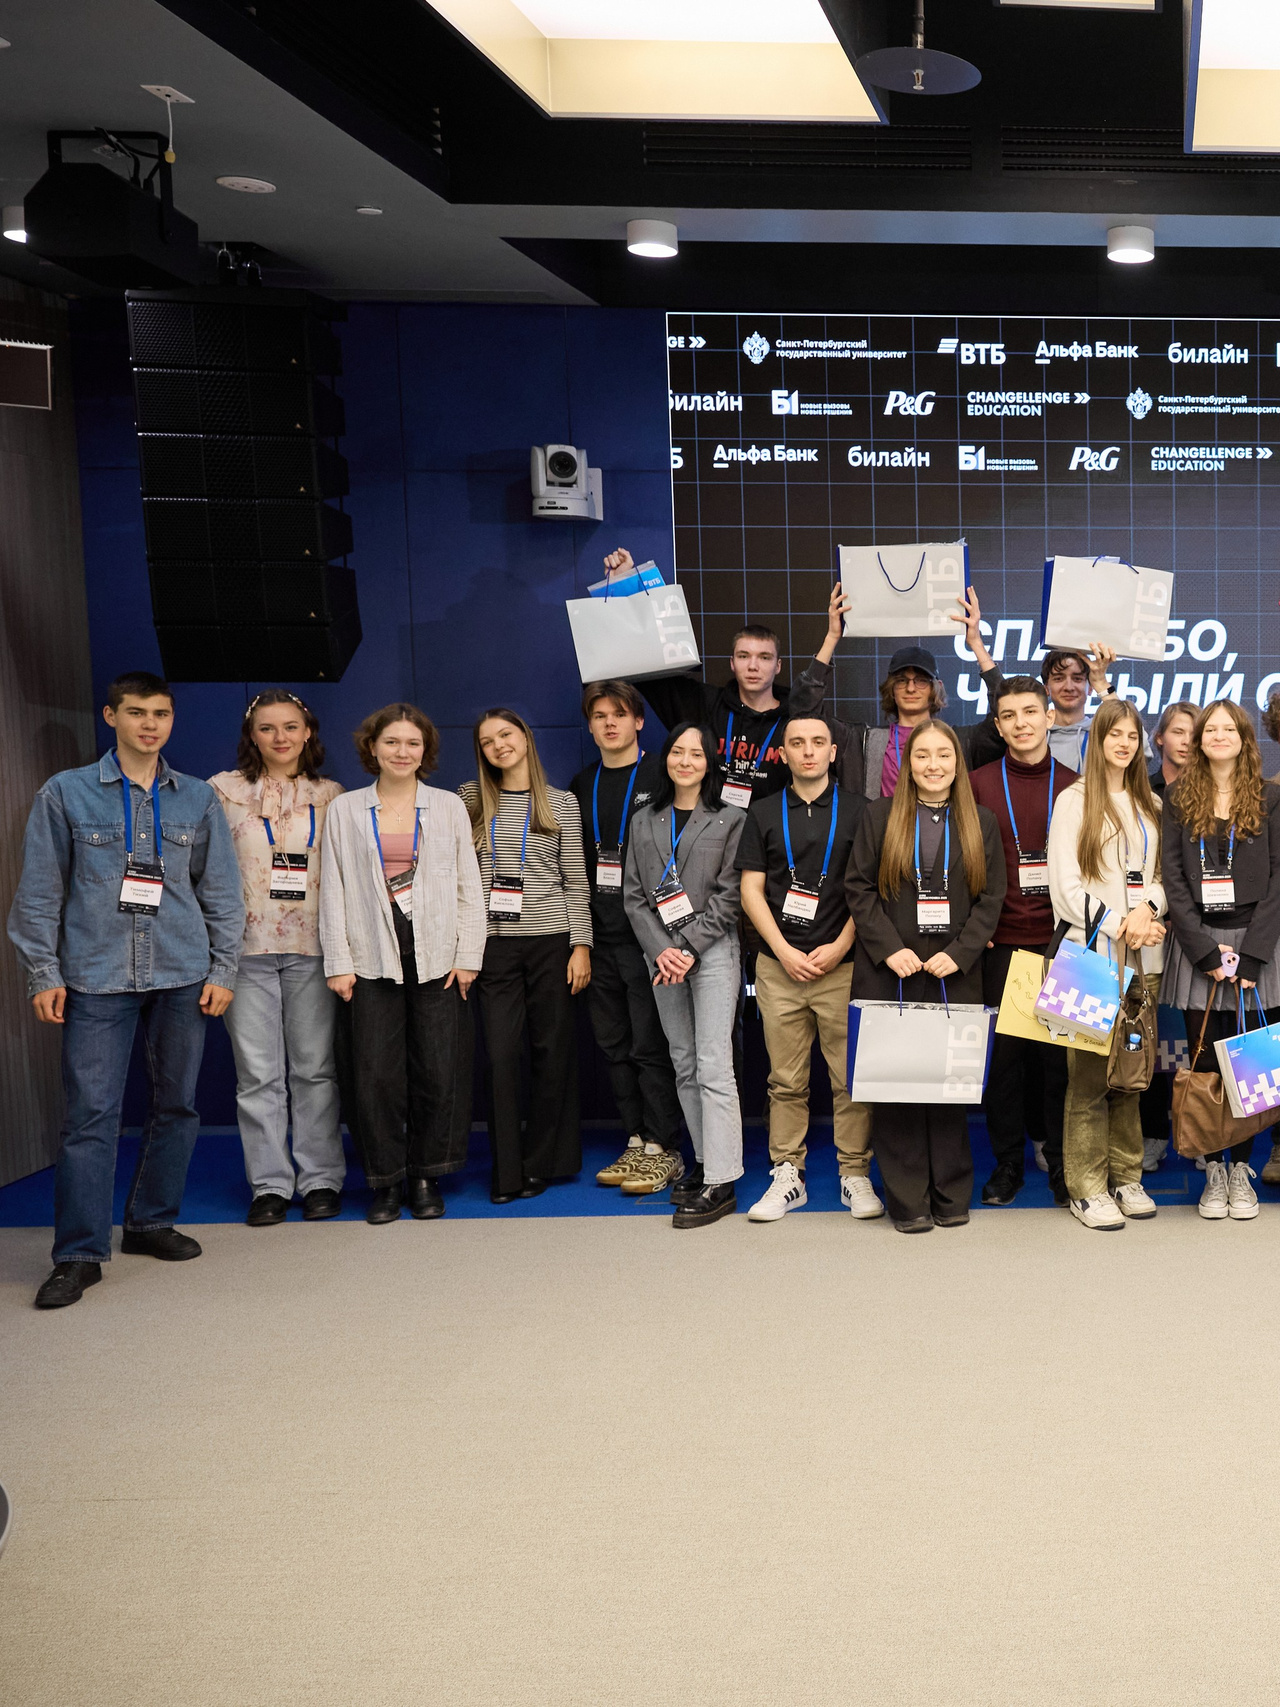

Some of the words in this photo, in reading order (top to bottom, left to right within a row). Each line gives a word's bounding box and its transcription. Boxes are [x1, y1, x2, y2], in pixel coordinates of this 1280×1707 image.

[776, 340, 867, 349] Санкт-Петербургский
[961, 344, 1006, 364] ВТБ
[1036, 341, 1092, 361] Альфа
[1096, 342, 1138, 358] Банк
[1168, 343, 1248, 363] билайн
[776, 350, 850, 359] государственный
[852, 351, 907, 360] университет
[884, 391, 936, 415] P&G
[967, 392, 1070, 403] CHANGELLENGE
[1158, 396, 1247, 405] Санкт-Петербургский
[968, 405, 1041, 416] EDUCATION
[1159, 406, 1231, 414] государственный
[714, 445, 771, 465] Альфа
[774, 445, 818, 461] Банк
[848, 446, 930, 467] билайн
[1069, 447, 1120, 471] P&G
[1151, 447, 1252, 458] CHANGELLENGE
[1151, 460, 1224, 471] EDUCATION
[926, 558, 961, 631] ВТБ
[1129, 580, 1168, 655] ВТБ
[651, 594, 697, 665] ВТБ
[954, 619, 1238, 672] СПБО,
[943, 1024, 982, 1098] ВТБ
